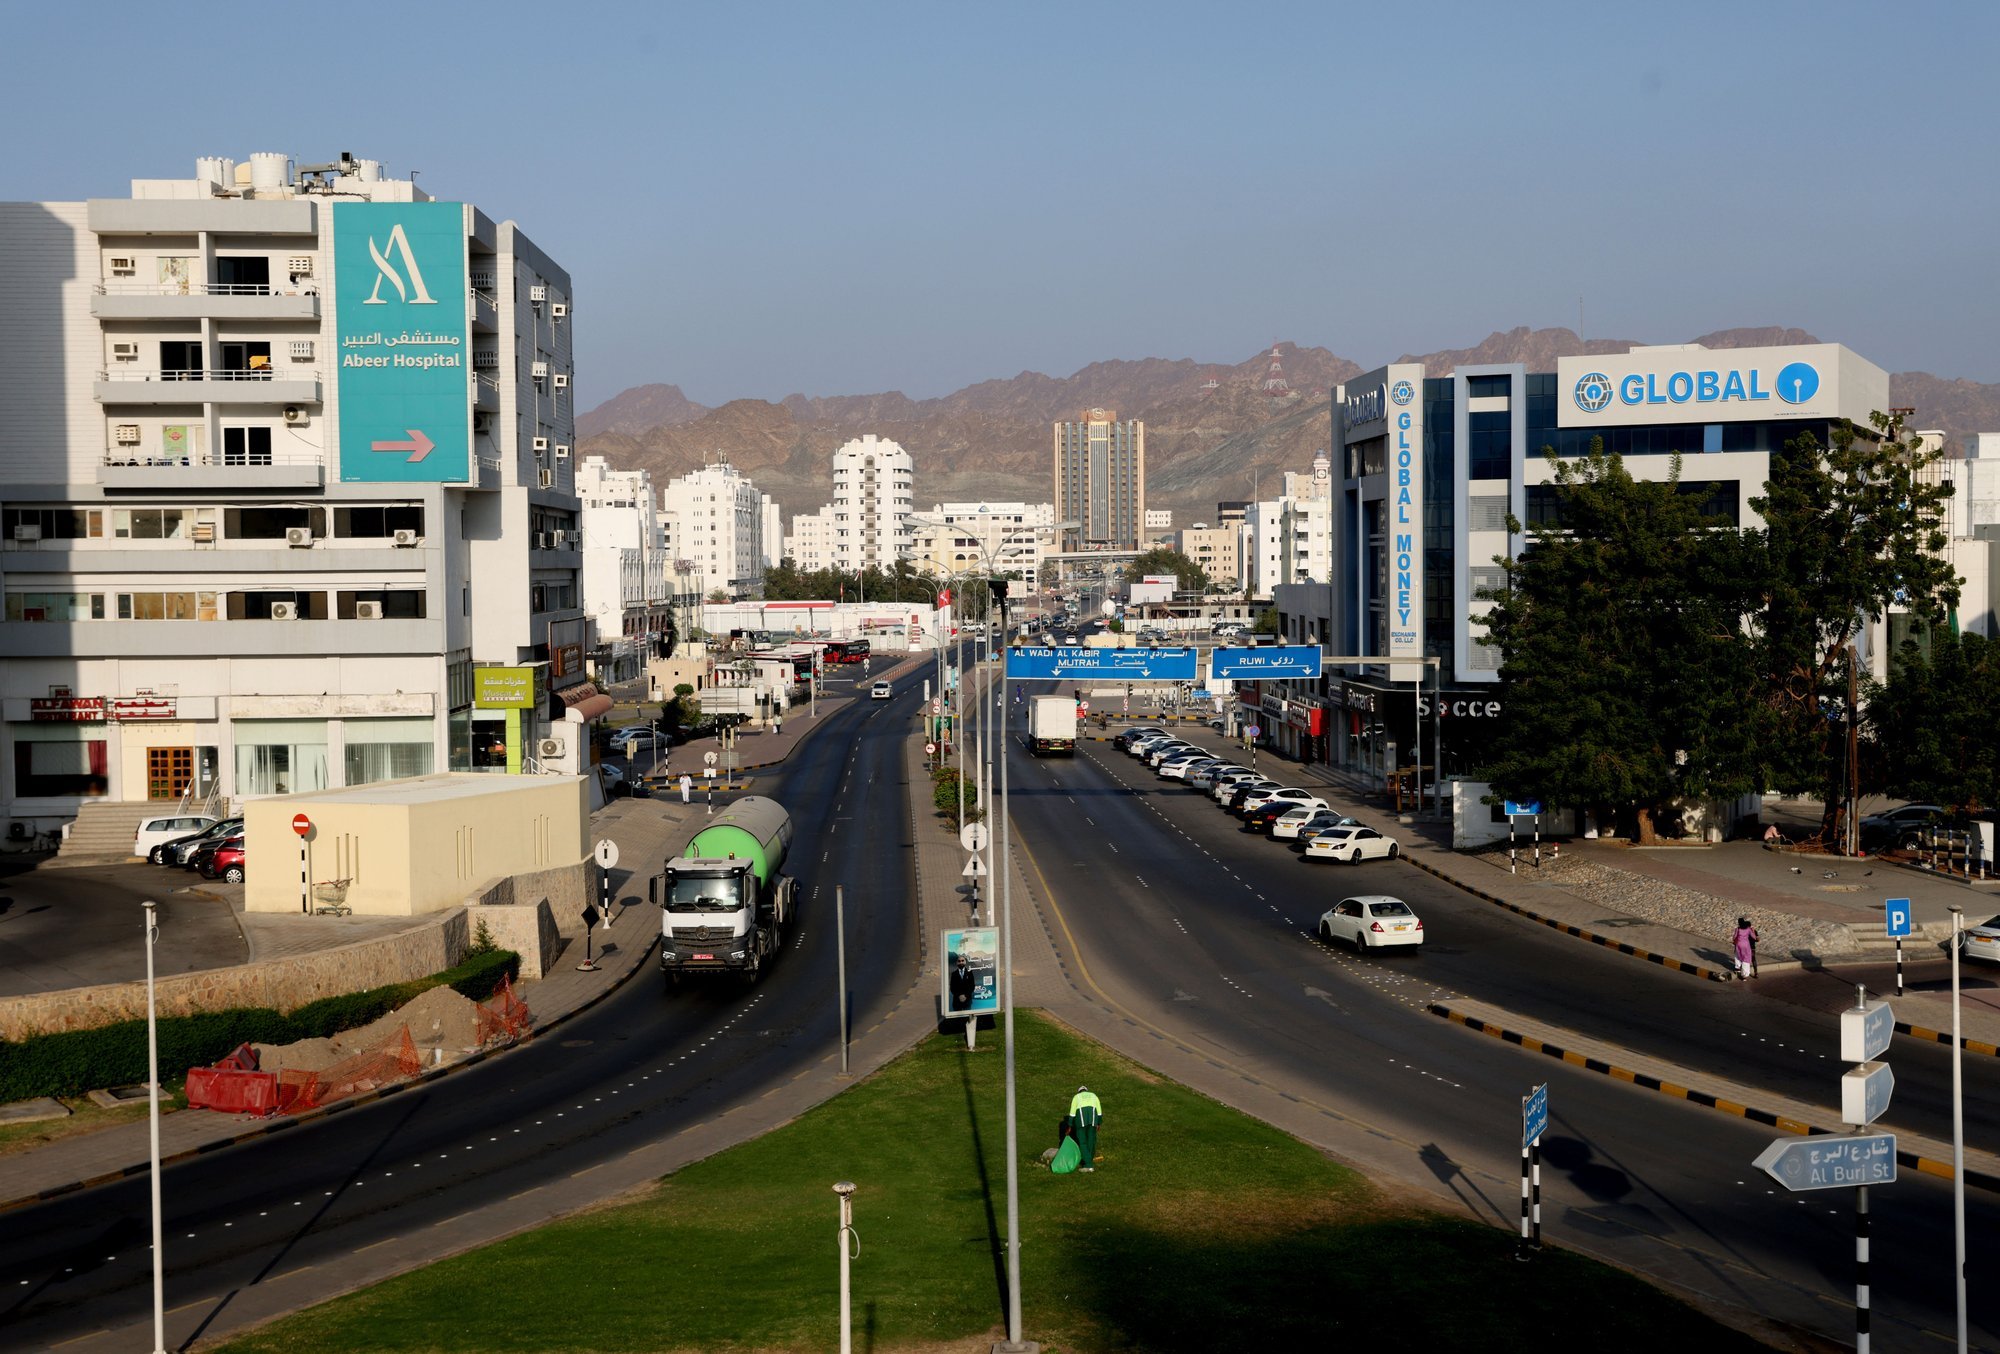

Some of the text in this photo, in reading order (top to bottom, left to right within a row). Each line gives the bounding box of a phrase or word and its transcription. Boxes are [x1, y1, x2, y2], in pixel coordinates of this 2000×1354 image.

[342, 330, 460, 348] مستشفى العبير
[343, 353, 460, 370] Abeer Hospital
[1619, 369, 1770, 406] GLOBAL
[1351, 389, 1378, 425] GLOBAL
[1397, 412, 1412, 627] GLOBAL MONEY
[1057, 659, 1100, 667] MUTRAH
[1109, 650, 1188, 660] الوادي الكبير
[1114, 659, 1146, 667] مطرح
[1239, 657, 1266, 665] RUWI
[1270, 656, 1294, 667] روي
[504, 676, 527, 687] سفريات
[1892, 911, 1905, 931] P
[1810, 1140, 1889, 1163] شارع البرج
[1811, 1163, 1889, 1183] Al Burj St
